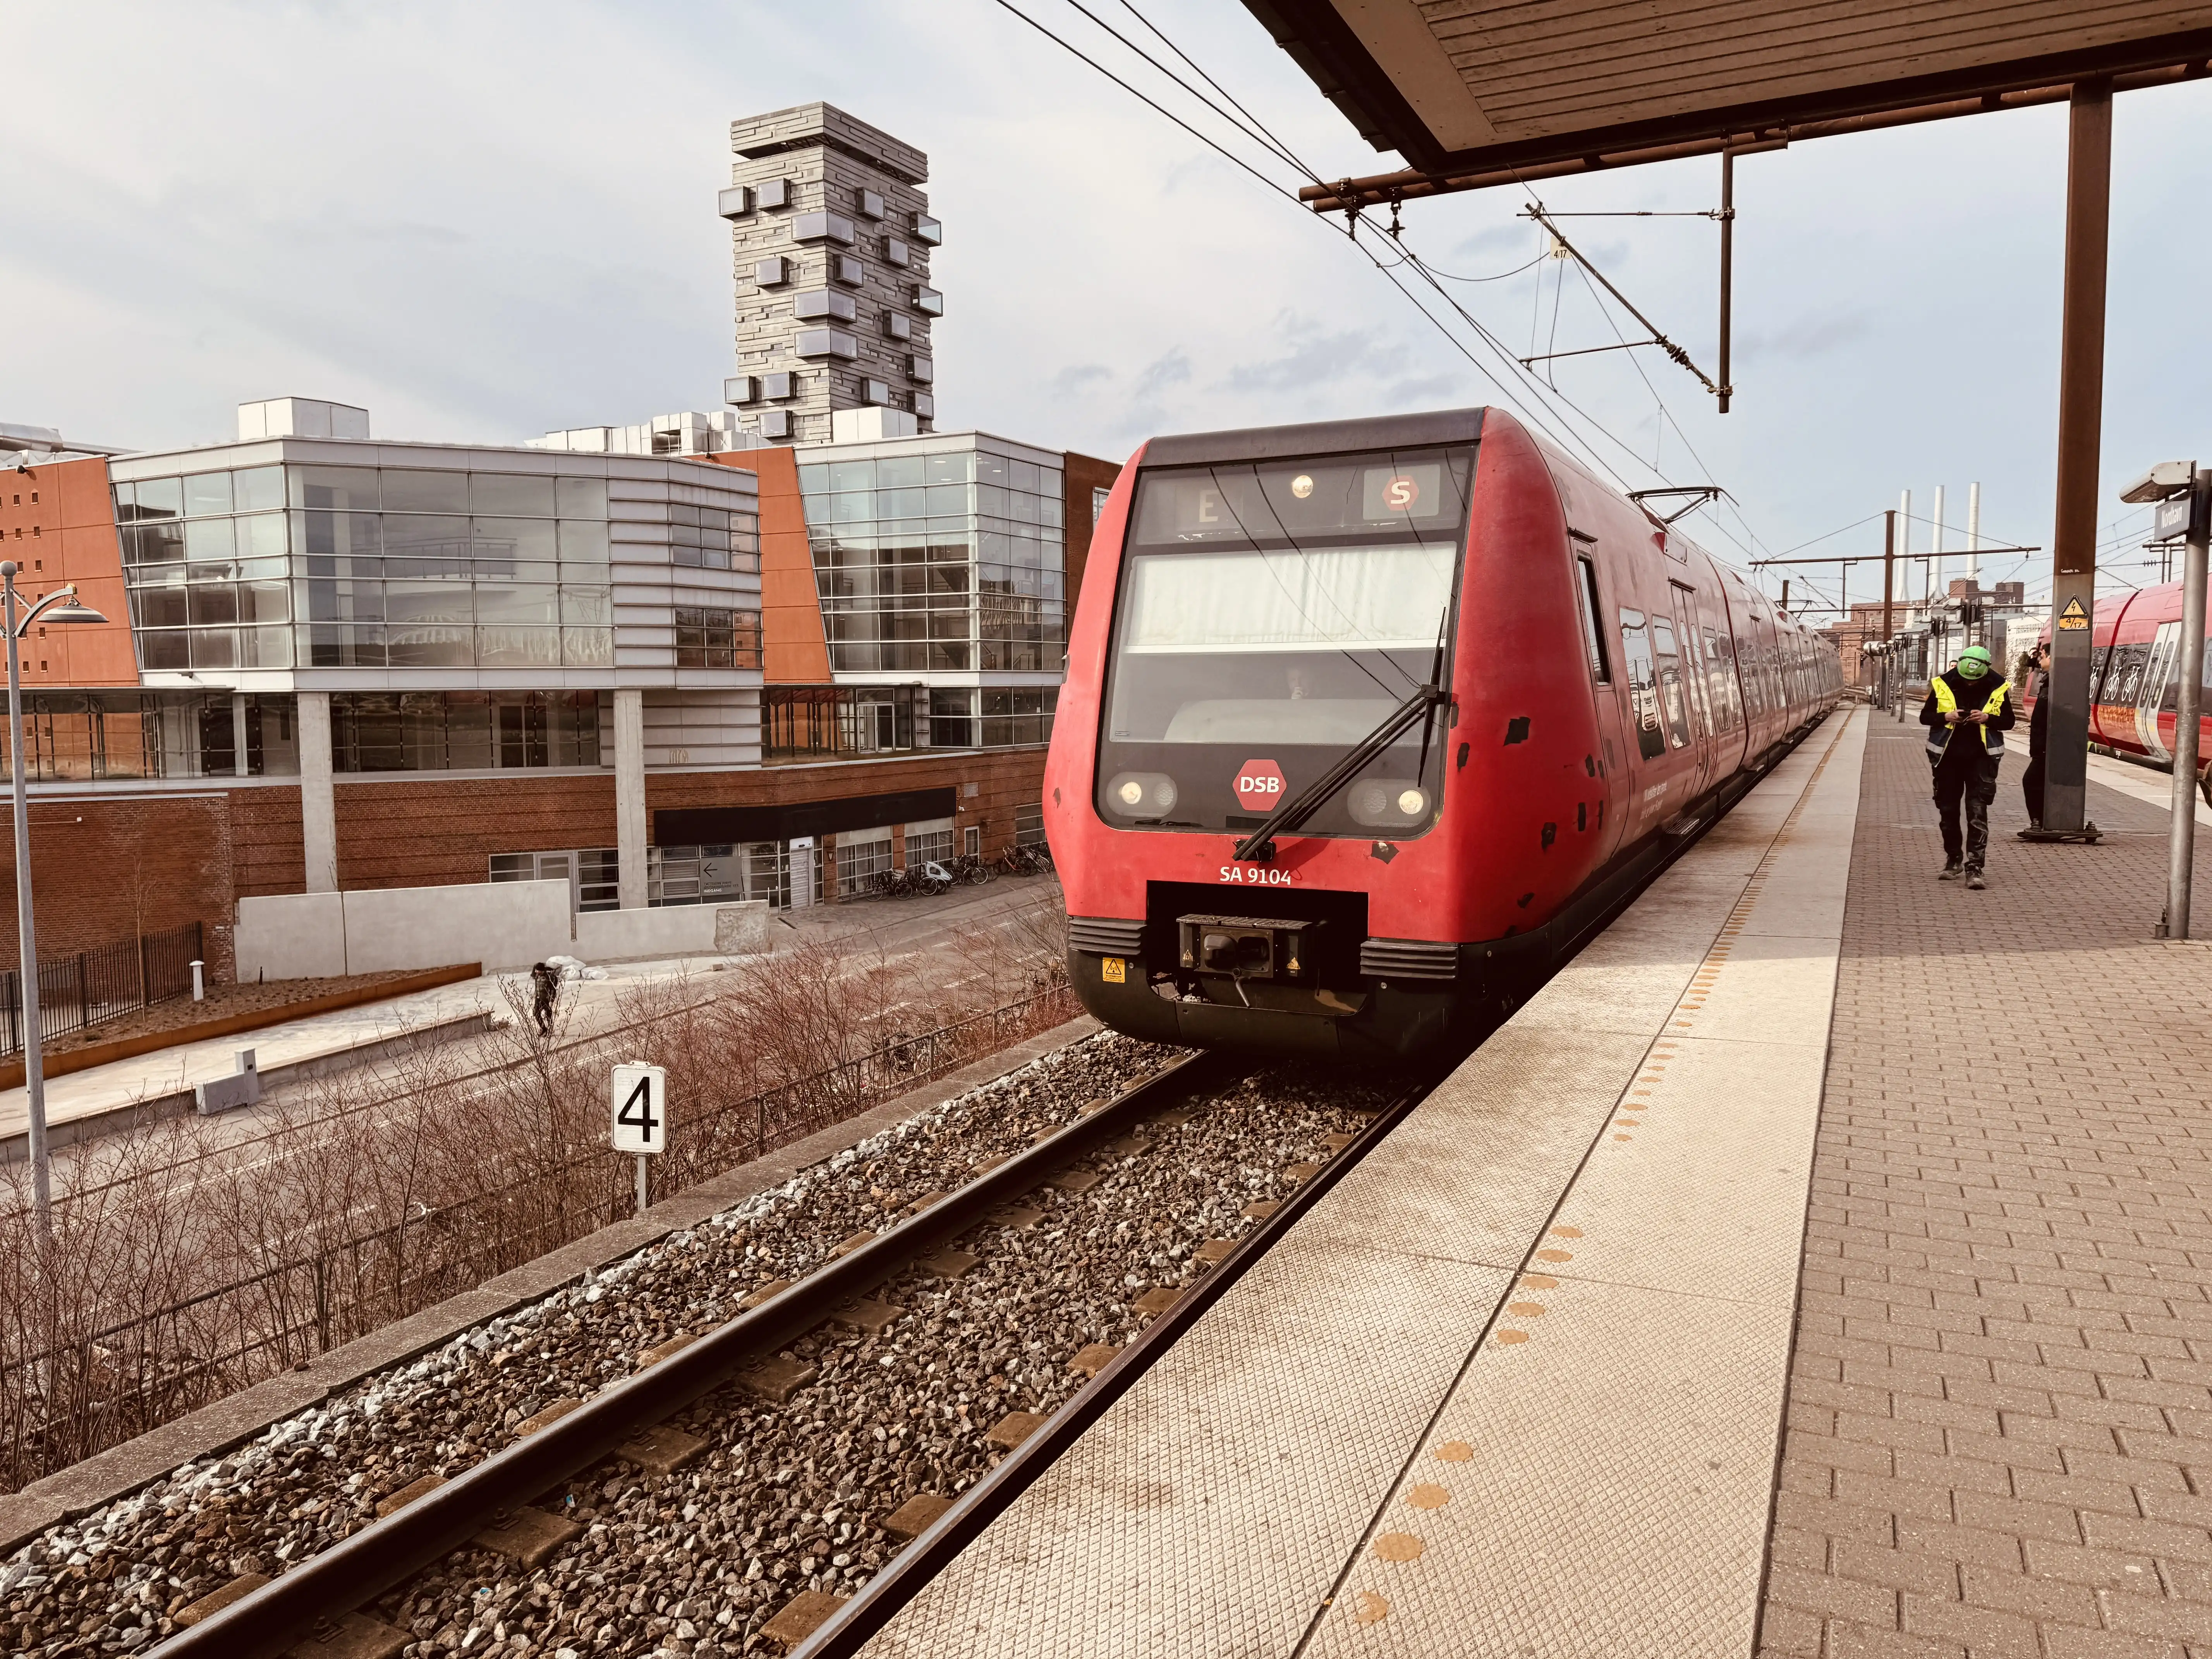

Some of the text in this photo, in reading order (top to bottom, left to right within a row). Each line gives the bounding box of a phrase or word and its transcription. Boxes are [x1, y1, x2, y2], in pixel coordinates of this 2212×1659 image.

[1554, 249, 1567, 258] 4/17
[1390, 481, 1410, 504] S
[1199, 489, 1218, 522] E
[2161, 504, 2182, 529] Nordhavn
[1240, 776, 1279, 793] DSB
[1220, 866, 1291, 885] SA 9104
[618, 1076, 658, 1142] 4
